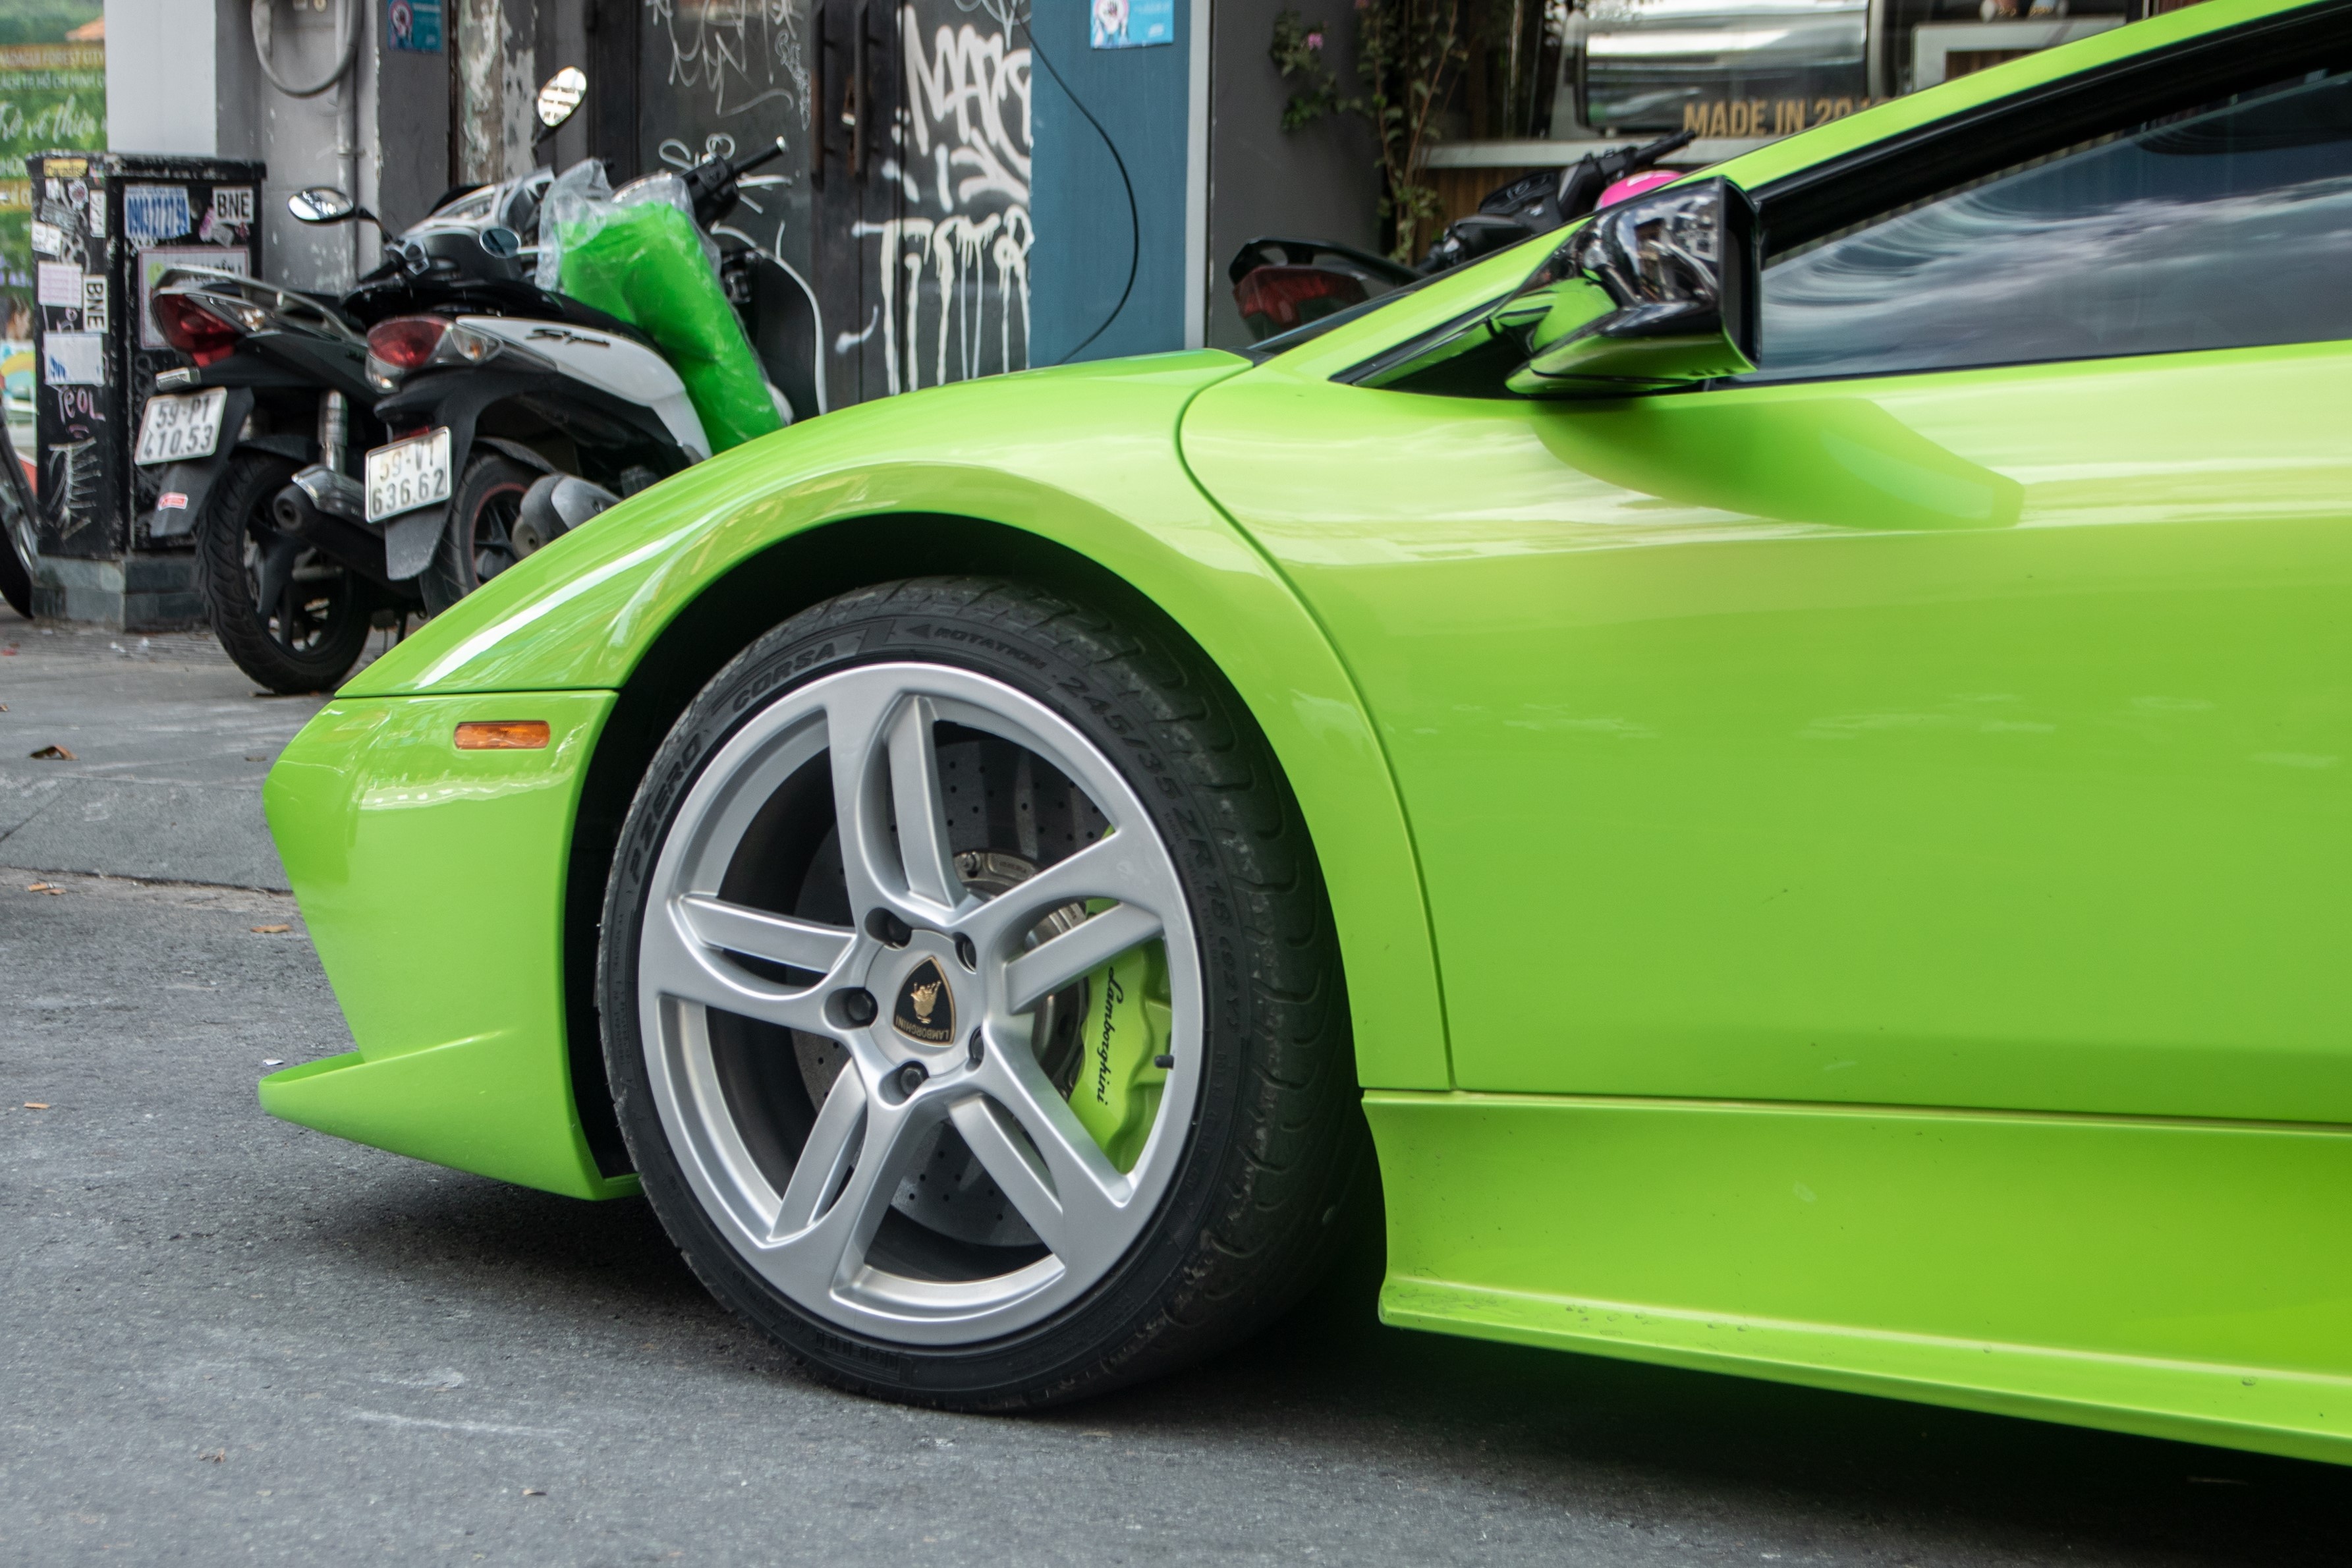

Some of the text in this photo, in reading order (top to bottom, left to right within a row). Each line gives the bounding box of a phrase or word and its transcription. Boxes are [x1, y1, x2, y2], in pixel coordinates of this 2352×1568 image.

[1683, 99, 1768, 137] MADE
[1775, 99, 1806, 135] IN
[217, 193, 249, 218] BNE
[86, 283, 104, 329] BNE
[372, 468, 444, 515] 636.62
[936, 627, 1046, 670] ROTATION
[640, 733, 702, 852] ZERO
[732, 642, 836, 713] CORSA
[1059, 674, 1183, 800] 245/35
[895, 1015, 949, 1040] LAMBORGHINI
[1097, 966, 1123, 1106] Lamborghini
